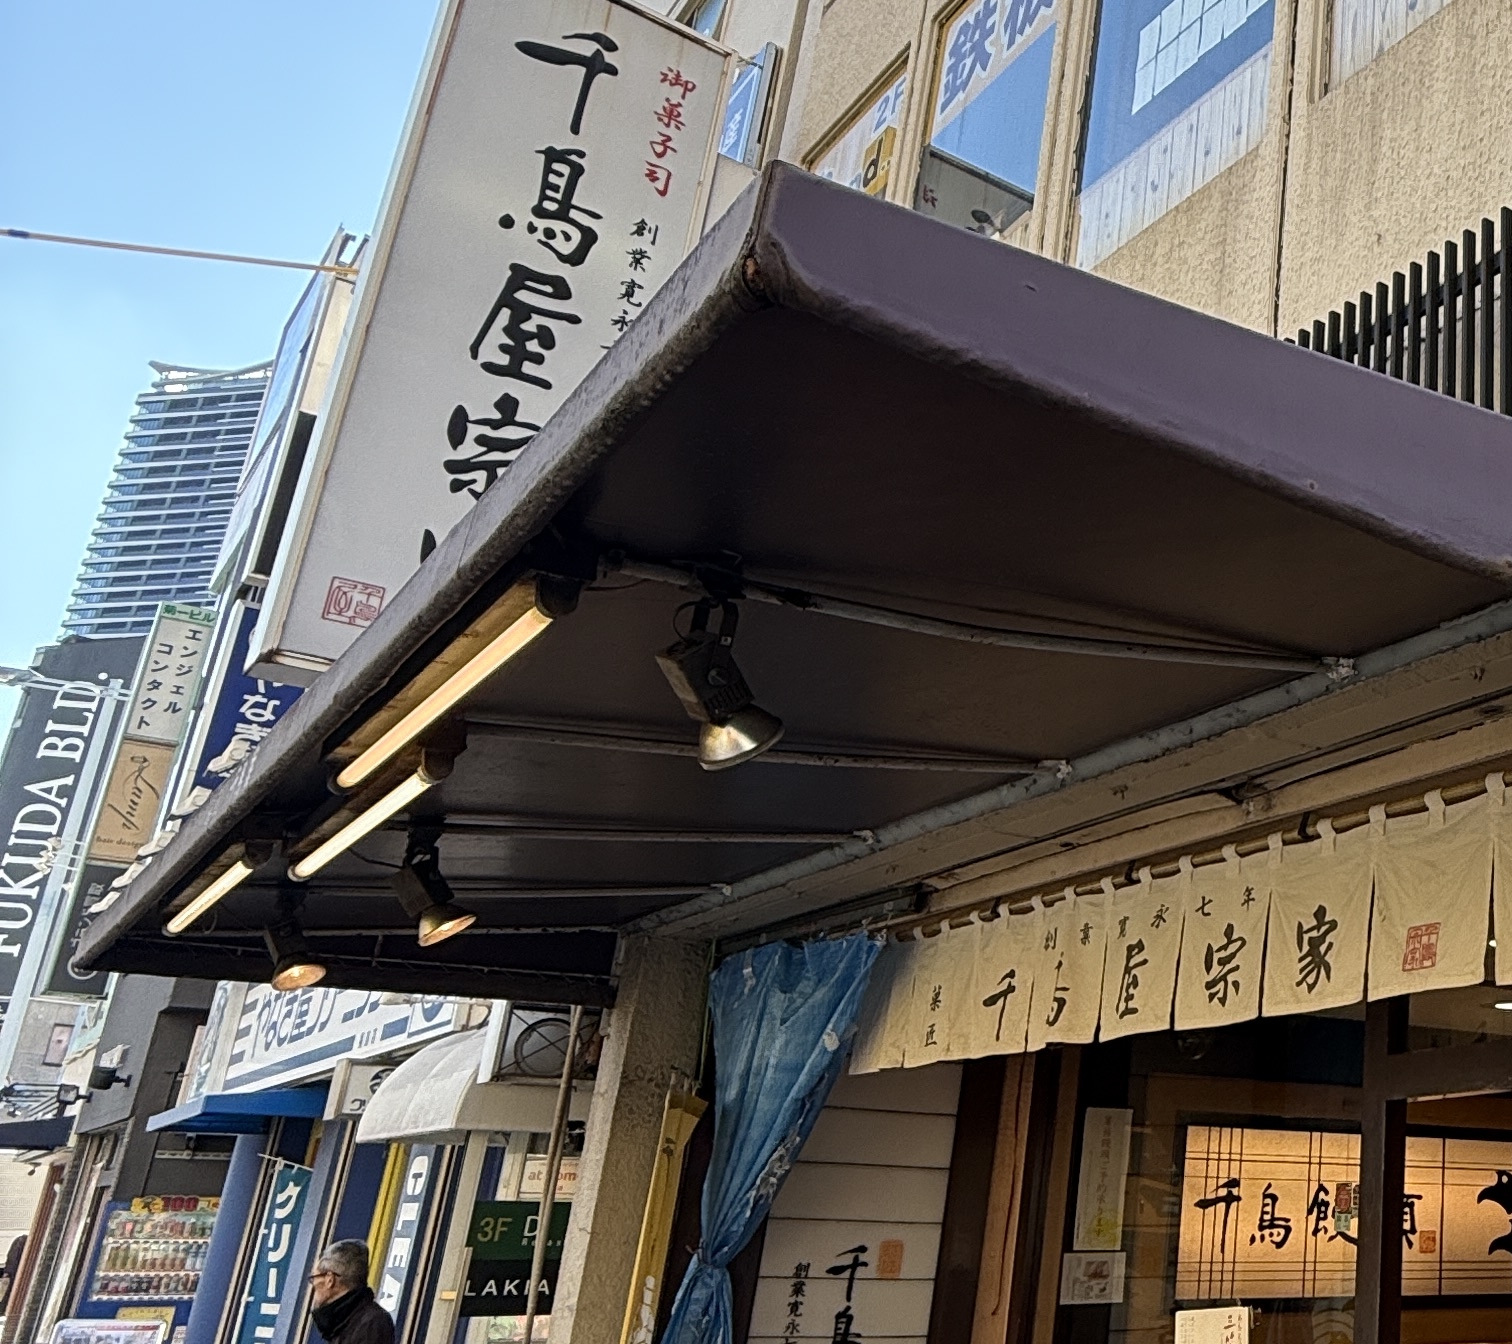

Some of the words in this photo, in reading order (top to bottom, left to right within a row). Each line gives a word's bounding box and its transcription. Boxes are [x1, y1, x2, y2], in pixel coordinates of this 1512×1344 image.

[641, 66, 697, 199] 御菓子司
[872, 76, 907, 133] 2F
[420, 30, 620, 564] 千鳥屋宗
[600, 217, 660, 353] 創業寛永
[136, 642, 174, 730] コンタクト
[163, 628, 203, 715] エンジェル
[36, 672, 109, 764] BLD.
[1043, 886, 1257, 952] 創業寛永七年
[478, 1217, 513, 1242] 3F
